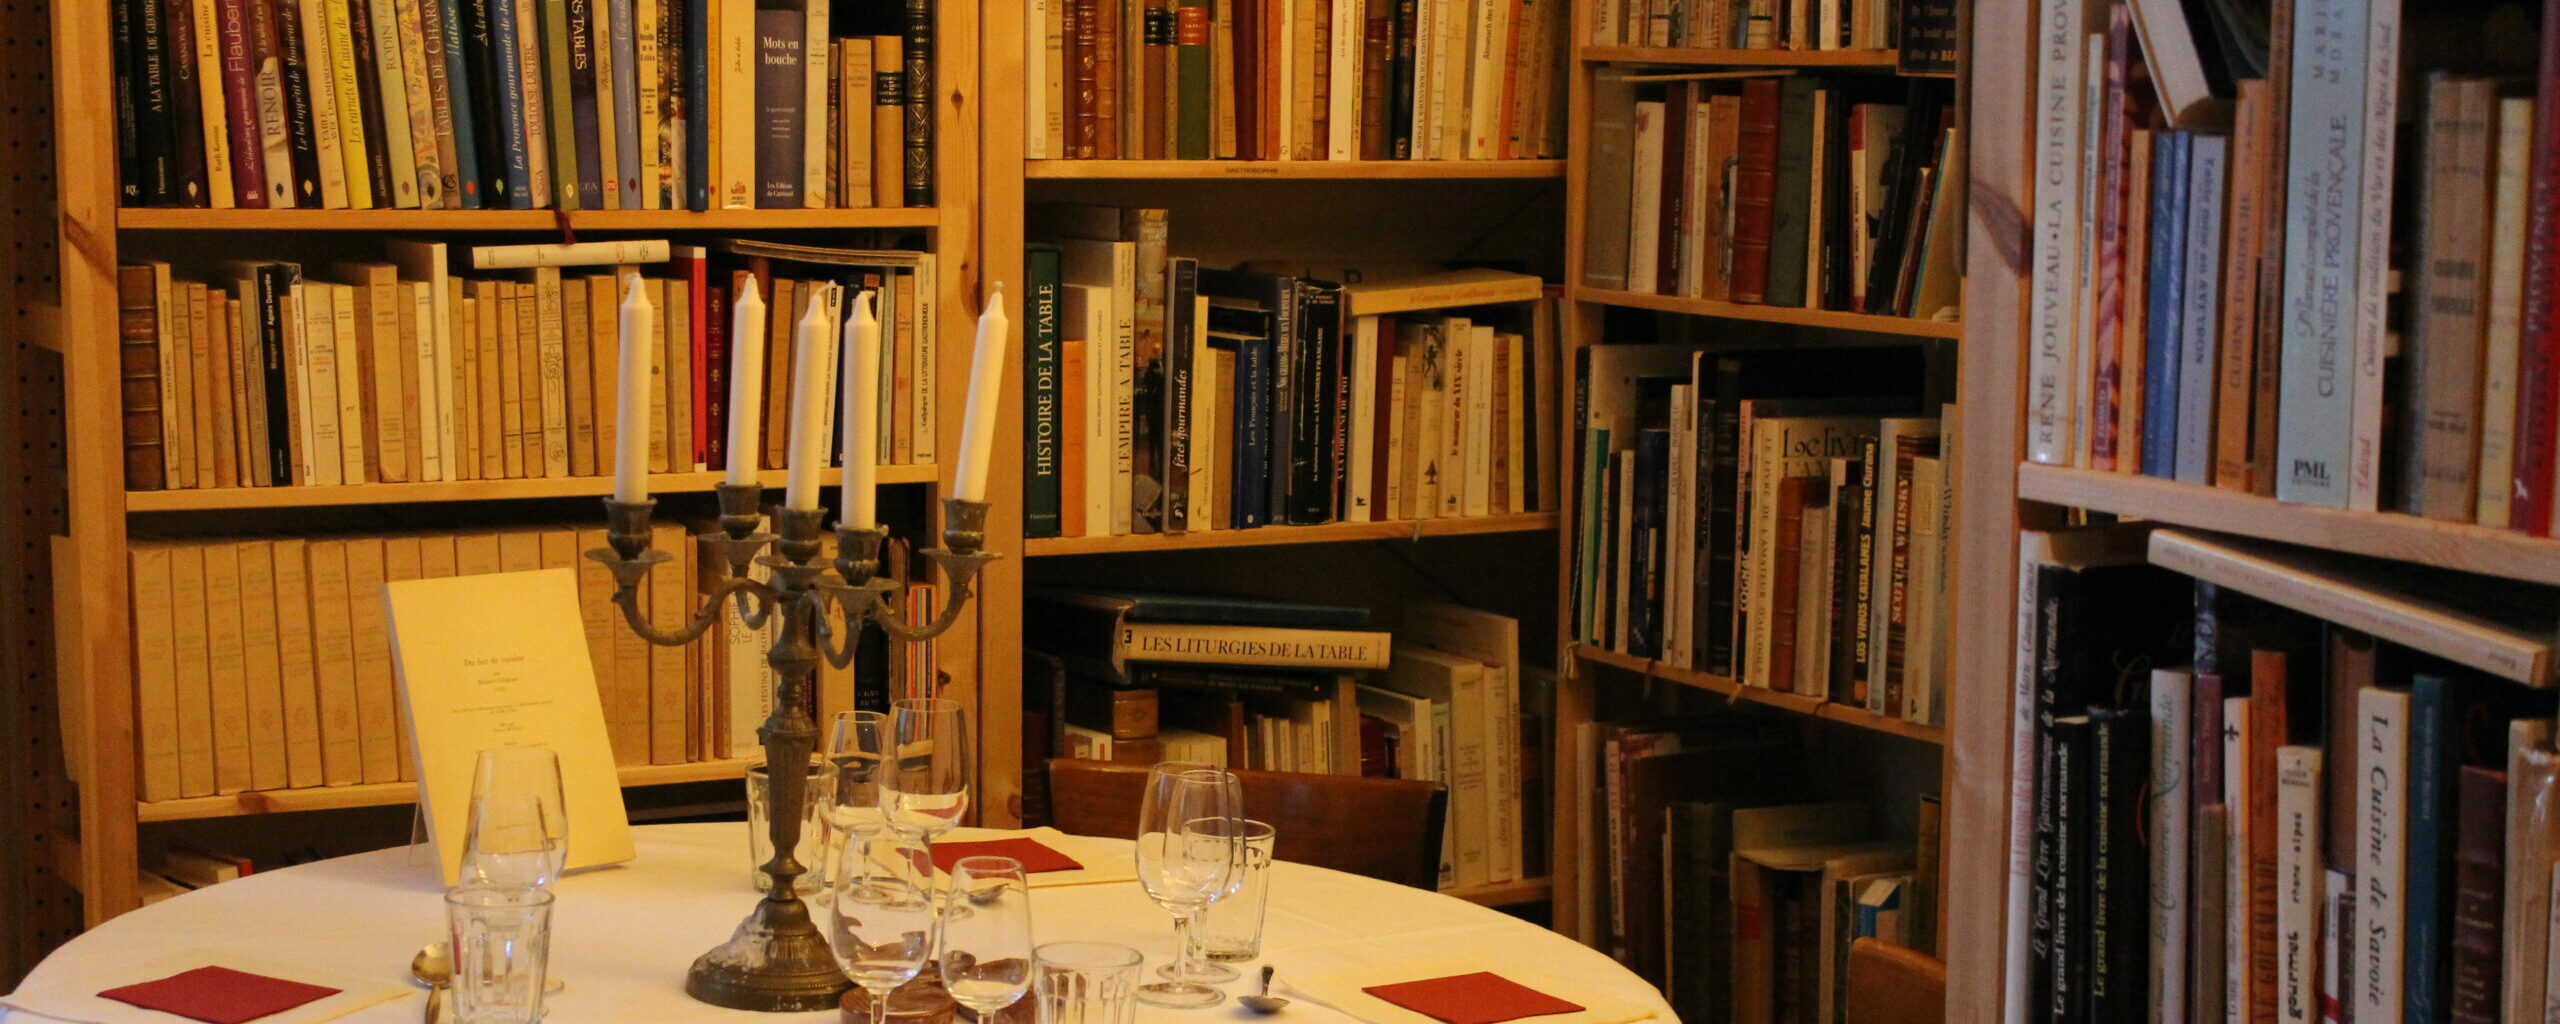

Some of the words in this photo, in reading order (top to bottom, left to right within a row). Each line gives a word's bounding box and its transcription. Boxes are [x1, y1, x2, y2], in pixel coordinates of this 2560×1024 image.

[200, 5, 211, 41] cuisine
[281, 8, 292, 21] de
[335, 18, 347, 29] de
[502, 19, 512, 30] de
[1485, 9, 1494, 22] des
[147, 36, 158, 49] DE
[203, 44, 213, 57] La
[285, 23, 298, 67] Monsieur
[337, 30, 351, 69] Cuisine
[381, 25, 397, 70] RODIN
[573, 16, 588, 70] TABLES
[763, 37, 785, 50] Mots
[787, 41, 799, 50] en
[1483, 23, 1492, 59] Almanach
[2376, 23, 2392, 54] Sud
[148, 55, 160, 86] TABLE
[432, 62, 445, 78] DE
[502, 35, 519, 99] gourmande
[765, 52, 797, 65] bouche
[2376, 59, 2388, 79] du
[289, 71, 300, 83] de
[341, 72, 353, 84] de
[524, 43, 542, 137] TOULOUSE-LAUTREC
[151, 89, 162, 101] LA
[261, 70, 281, 136] RENOIR
[291, 85, 305, 119] appétit
[345, 86, 358, 124] carnets
[434, 84, 451, 139] TABLES
[2374, 83, 2391, 124] Alpes
[294, 121, 306, 135] bel
[320, 111, 329, 141] TABLE
[348, 126, 360, 143] Les
[510, 102, 522, 152] Provence
[2049, 77, 2066, 186] CUISINE
[2374, 129, 2386, 152] des
[296, 138, 308, 150] Le
[514, 156, 524, 170] La
[2372, 156, 2384, 171] et
[2082, 155, 2094, 224] provençale
[2202, 157, 2216, 204] Table
[2323, 115, 2348, 268] PROVENÇALE
[2371, 175, 2383, 201] Var
[2050, 199, 2062, 228] LA
[2200, 208, 2212, 249] mise
[2370, 208, 2382, 227] du
[2303, 207, 2319, 260] complet
[2081, 227, 2090, 275] cuisine
[2199, 253, 2210, 275] en
[2364, 232, 2380, 297] tradition
[264, 273, 272, 304] Desarthe
[2042, 245, 2061, 363] JOUVEAU
[2294, 262, 2316, 337] Manuel
[267, 305, 275, 326] Agnès
[1038, 283, 1053, 338] TABLE
[2194, 279, 2212, 366] AVEYRON
[2363, 303, 2377, 320] de
[1038, 341, 1053, 361] LA
[1118, 319, 1131, 372] TABLE
[2234, 314, 2246, 389] CUISINE
[2317, 276, 2339, 398] CUISINIÈRE
[2361, 328, 2378, 378] Cuisine
[1249, 369, 1258, 378] la
[1250, 346, 1259, 368] table
[1454, 350, 1463, 373] siècle
[1038, 365, 1053, 391] DE
[1250, 381, 1258, 389] et
[1176, 369, 1188, 440] gourmandes
[1249, 391, 1258, 428] Français
[1453, 397, 1461, 408] du
[2038, 374, 2056, 444] RENÉ
[1037, 395, 1053, 476] HISTOIRE
[1118, 396, 1131, 474] L'EMPIRE
[1249, 431, 1257, 446] Les
[1453, 410, 1462, 446] mangeur
[1764, 437, 1772, 452] LE
[1783, 427, 1822, 457] Le
[1173, 442, 1188, 467] fêtes
[1861, 443, 1874, 487] Ciurana
[2293, 459, 2326, 479] PML
[1763, 461, 1772, 495] LIVRE
[1762, 505, 1770, 520] DE
[1860, 490, 1873, 528] Jaume
[1894, 476, 1909, 547] WHISKY
[1759, 529, 1769, 598] L'AMATEUR
[1858, 534, 1871, 600] CATALANES
[1739, 550, 1750, 612] COGNAC
[1890, 553, 1906, 623] SCOTCH
[730, 602, 741, 644] SOPHIE
[742, 632, 752, 642] LE
[1857, 603, 1869, 638] VINOS
[2020, 612, 2033, 653] Claude
[1142, 636, 1172, 652] LES
[1176, 638, 1267, 657] LITURGIES
[1270, 642, 1292, 657] DE
[1294, 643, 1314, 659] LA
[1317, 645, 1368, 661] TABLE
[1755, 607, 1767, 675] D'ALCOOLS
[1856, 641, 1867, 662] LOS
[464, 658, 475, 667] Du
[477, 656, 489, 666] fait
[491, 656, 498, 664] de
[499, 654, 525, 664] cuisine
[760, 656, 768, 668] DE
[760, 670, 768, 702] FESTINS
[2020, 665, 2032, 697] Marie
[2042, 689, 2055, 704] la
[761, 703, 769, 718] LES
[2020, 707, 2029, 721] de
[2041, 710, 2054, 728] de
[2370, 714, 2389, 754] La
[2098, 723, 2109, 798] normande
[2036, 731, 2055, 832] Gastronomique
[2057, 742, 2068, 817] normande
[2099, 801, 2109, 853] cuisine
[2368, 765, 2388, 866] Cuisine
[2058, 821, 2068, 872] cuisine
[2292, 812, 2303, 854] alpes
[2034, 839, 2050, 880] Livre
[2097, 857, 2108, 870] la
[2056, 875, 2067, 889] la
[2097, 873, 2107, 891] de
[2291, 865, 2301, 903] rhone
[2368, 877, 2387, 909] de
[2032, 885, 2050, 930] Grand
[2057, 892, 2067, 909] de
[2095, 895, 2106, 926] livre
[2055, 912, 2066, 945] livre
[2033, 938, 2049, 958] Le
[2095, 929, 2107, 973] grand
[2367, 918, 2387, 1006] Savoie
[2055, 948, 2067, 992] grand
[2093, 975, 2106, 997] Le
[2287, 931, 2302, 1020] gourmet
[2054, 999, 2066, 1015] Le
